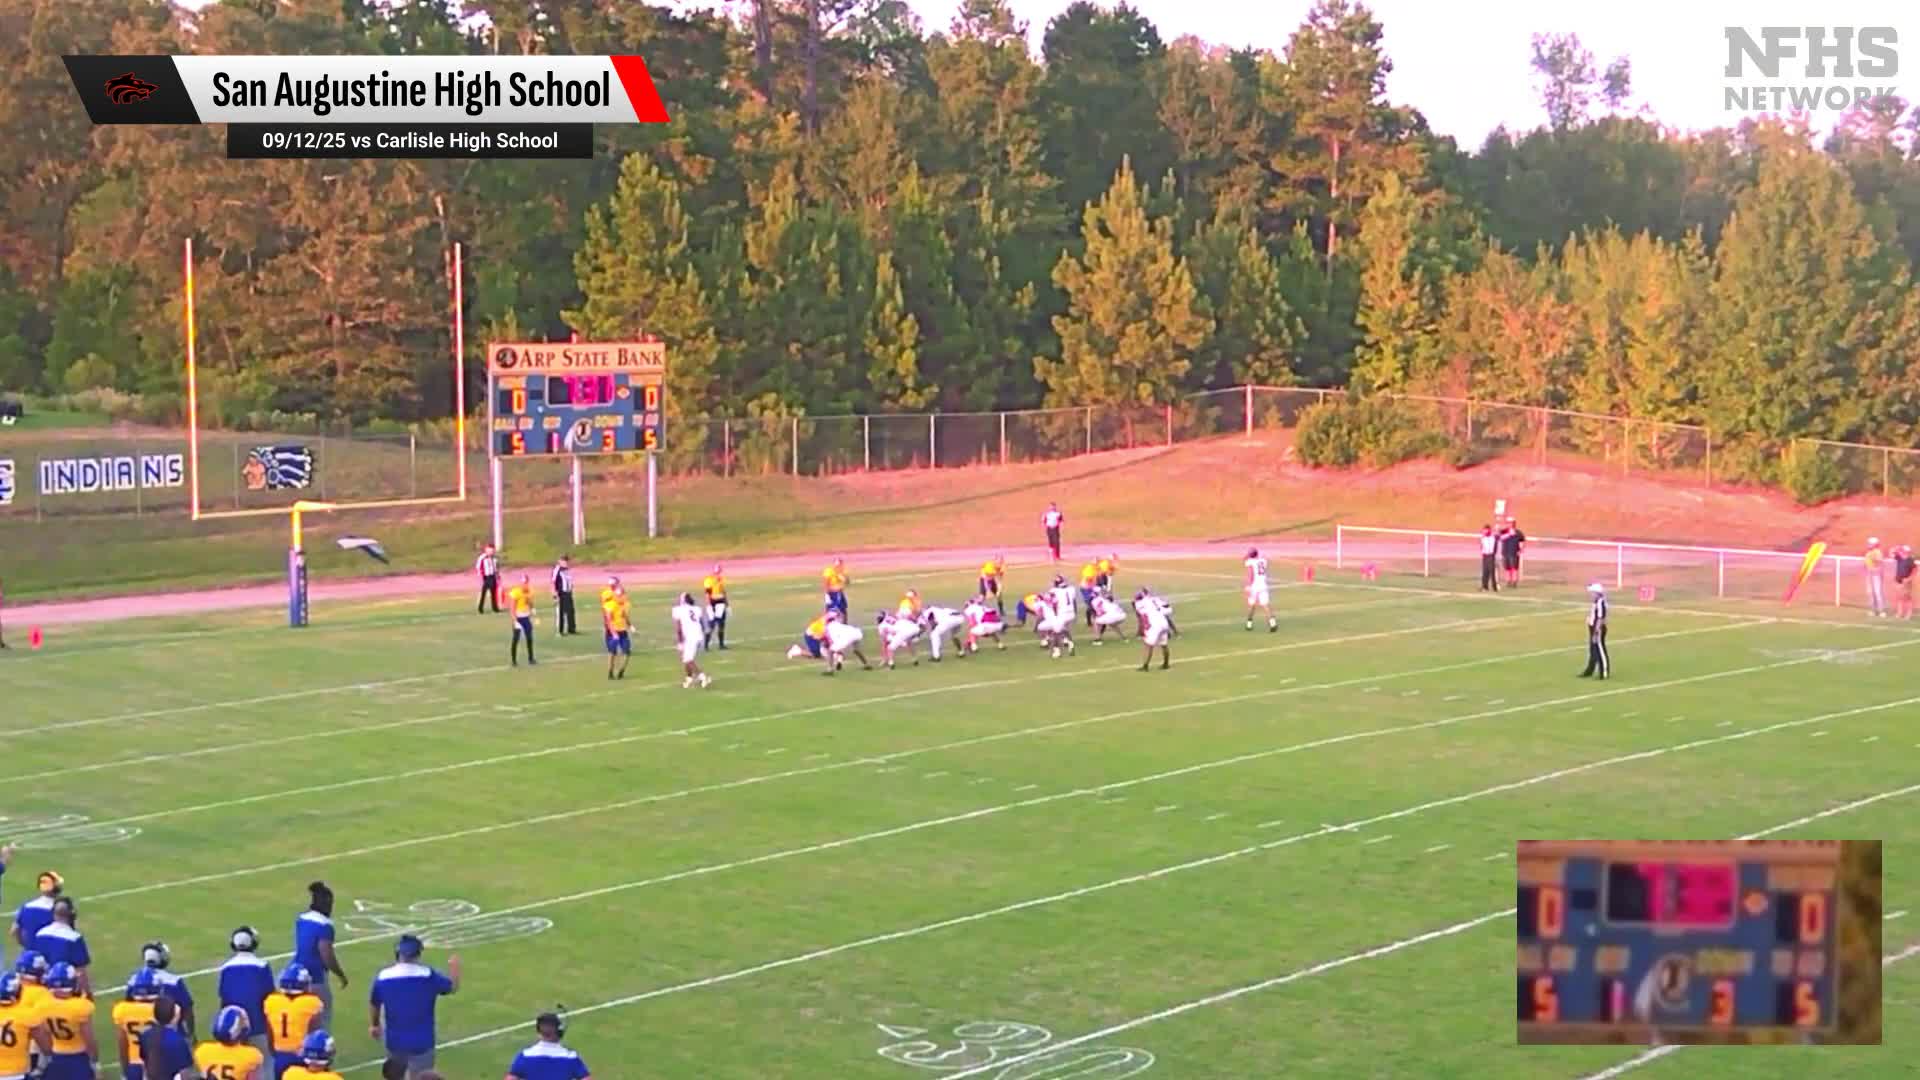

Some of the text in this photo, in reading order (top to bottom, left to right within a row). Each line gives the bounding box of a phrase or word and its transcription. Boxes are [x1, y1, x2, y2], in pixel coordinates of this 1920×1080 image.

[562, 348, 608, 367] STATE
[617, 347, 662, 366] BANK
[41, 454, 184, 494] INDIANS
[46, 1017, 75, 1041] 15
[281, 1012, 289, 1039] 1
